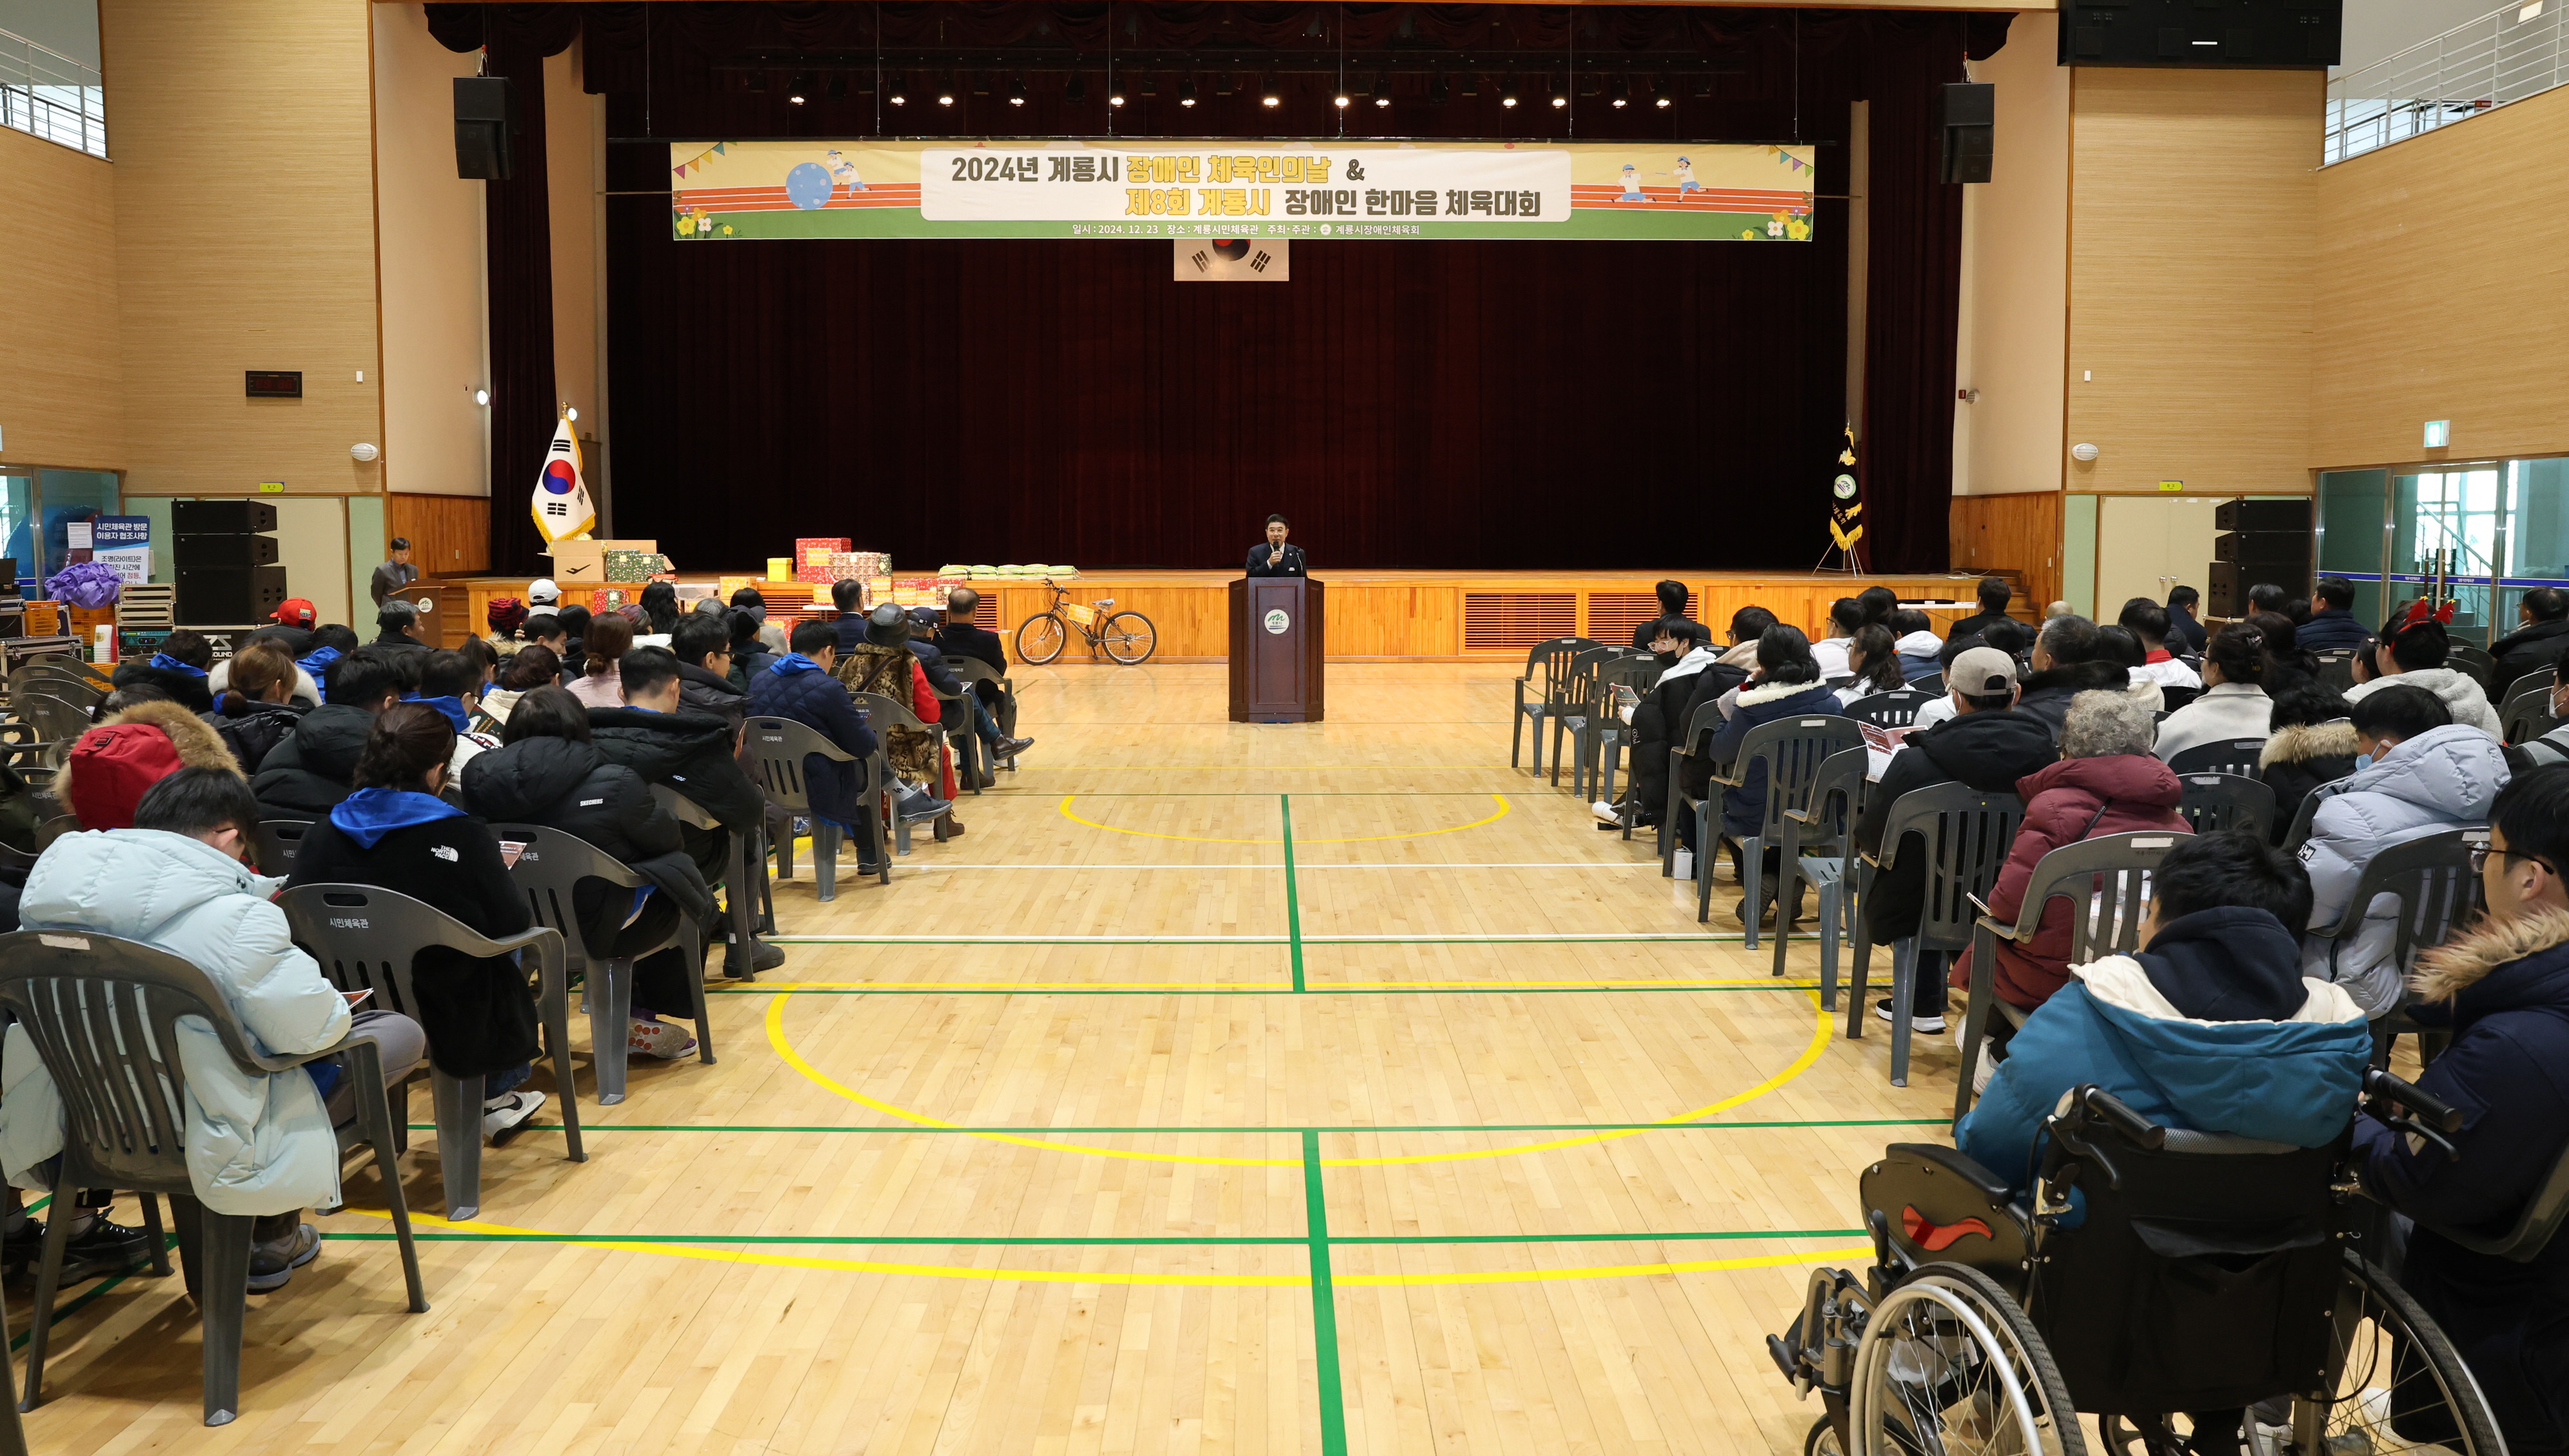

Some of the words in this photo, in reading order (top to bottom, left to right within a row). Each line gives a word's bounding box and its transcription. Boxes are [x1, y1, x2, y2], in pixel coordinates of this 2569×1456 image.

[952, 157, 1038, 182] 2024년
[1048, 157, 1119, 182] 계룡시
[1127, 156, 1200, 183] 장애인
[1207, 155, 1332, 183] 체육인의날
[1346, 159, 1365, 181] &
[1125, 188, 1190, 216] 제8회
[1198, 188, 1270, 216] 계룡시
[1285, 190, 1357, 215] 장애인
[1365, 188, 1438, 215] 한마음
[1445, 189, 1541, 217] 체육대회
[1128, 225, 1143, 234] 12.
[1146, 225, 1159, 234] 23
[1193, 224, 1259, 235] 계룡시민체육관
[1335, 224, 1420, 235] 계룡시장애인체육회
[580, 798, 604, 807] SKECHERS
[431, 847, 450, 856] NORTH
[330, 918, 369, 929] 시민체육관
